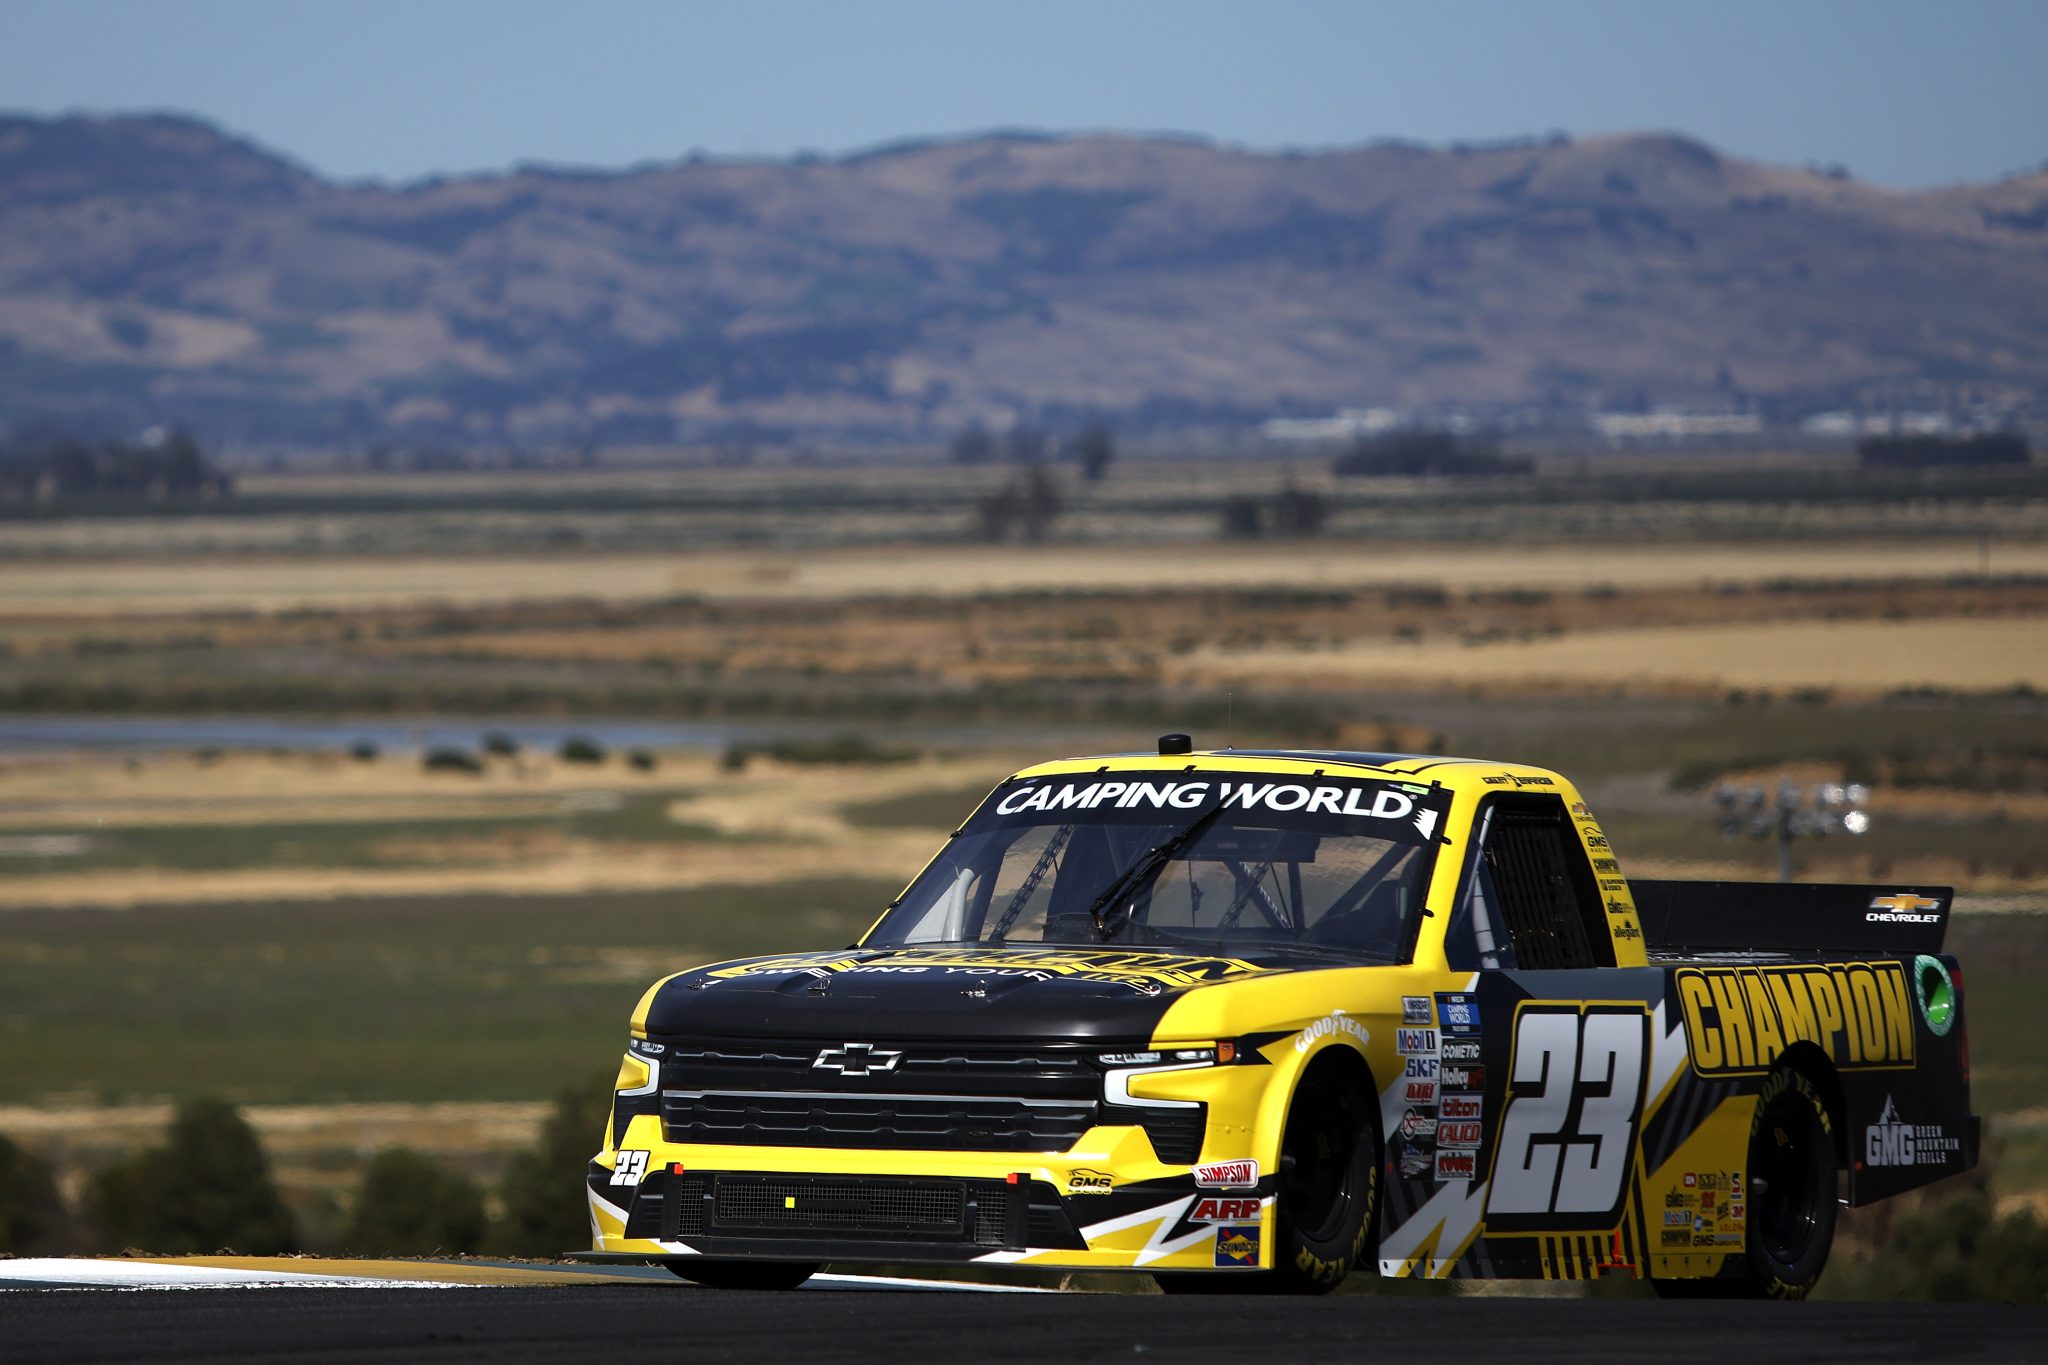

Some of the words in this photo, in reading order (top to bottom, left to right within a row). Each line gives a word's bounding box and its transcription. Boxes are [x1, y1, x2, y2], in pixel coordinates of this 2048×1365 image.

[996, 782, 1211, 815] CAMPING
[1219, 782, 1413, 819] WORLD
[1866, 913, 1941, 923] CHEVROLET
[945, 967, 1053, 981] YOUR
[1447, 1005, 1470, 1014] CAMPING
[1448, 1013, 1471, 1024] WORLD
[1679, 969, 1912, 1069] CHAMPION
[1398, 1030, 1425, 1050] Mobil
[1442, 1045, 1480, 1059] COMETIC
[1406, 1059, 1440, 1077] SKF
[1441, 1067, 1469, 1090] Holley
[1442, 1097, 1480, 1117] tilton
[1487, 1014, 1643, 1213] 23
[1439, 1123, 1481, 1142] CALICO
[1916, 1125, 1942, 1138] GREEN
[1866, 1125, 1915, 1167] GMG
[1916, 1139, 1959, 1151] MOUNTAIN
[1917, 1152, 1946, 1164] GRILLS
[609, 1150, 651, 1187] 23
[1199, 1164, 1252, 1183] SIMPSON
[1069, 1177, 1112, 1187] GMS
[1193, 1199, 1261, 1219] ARP
